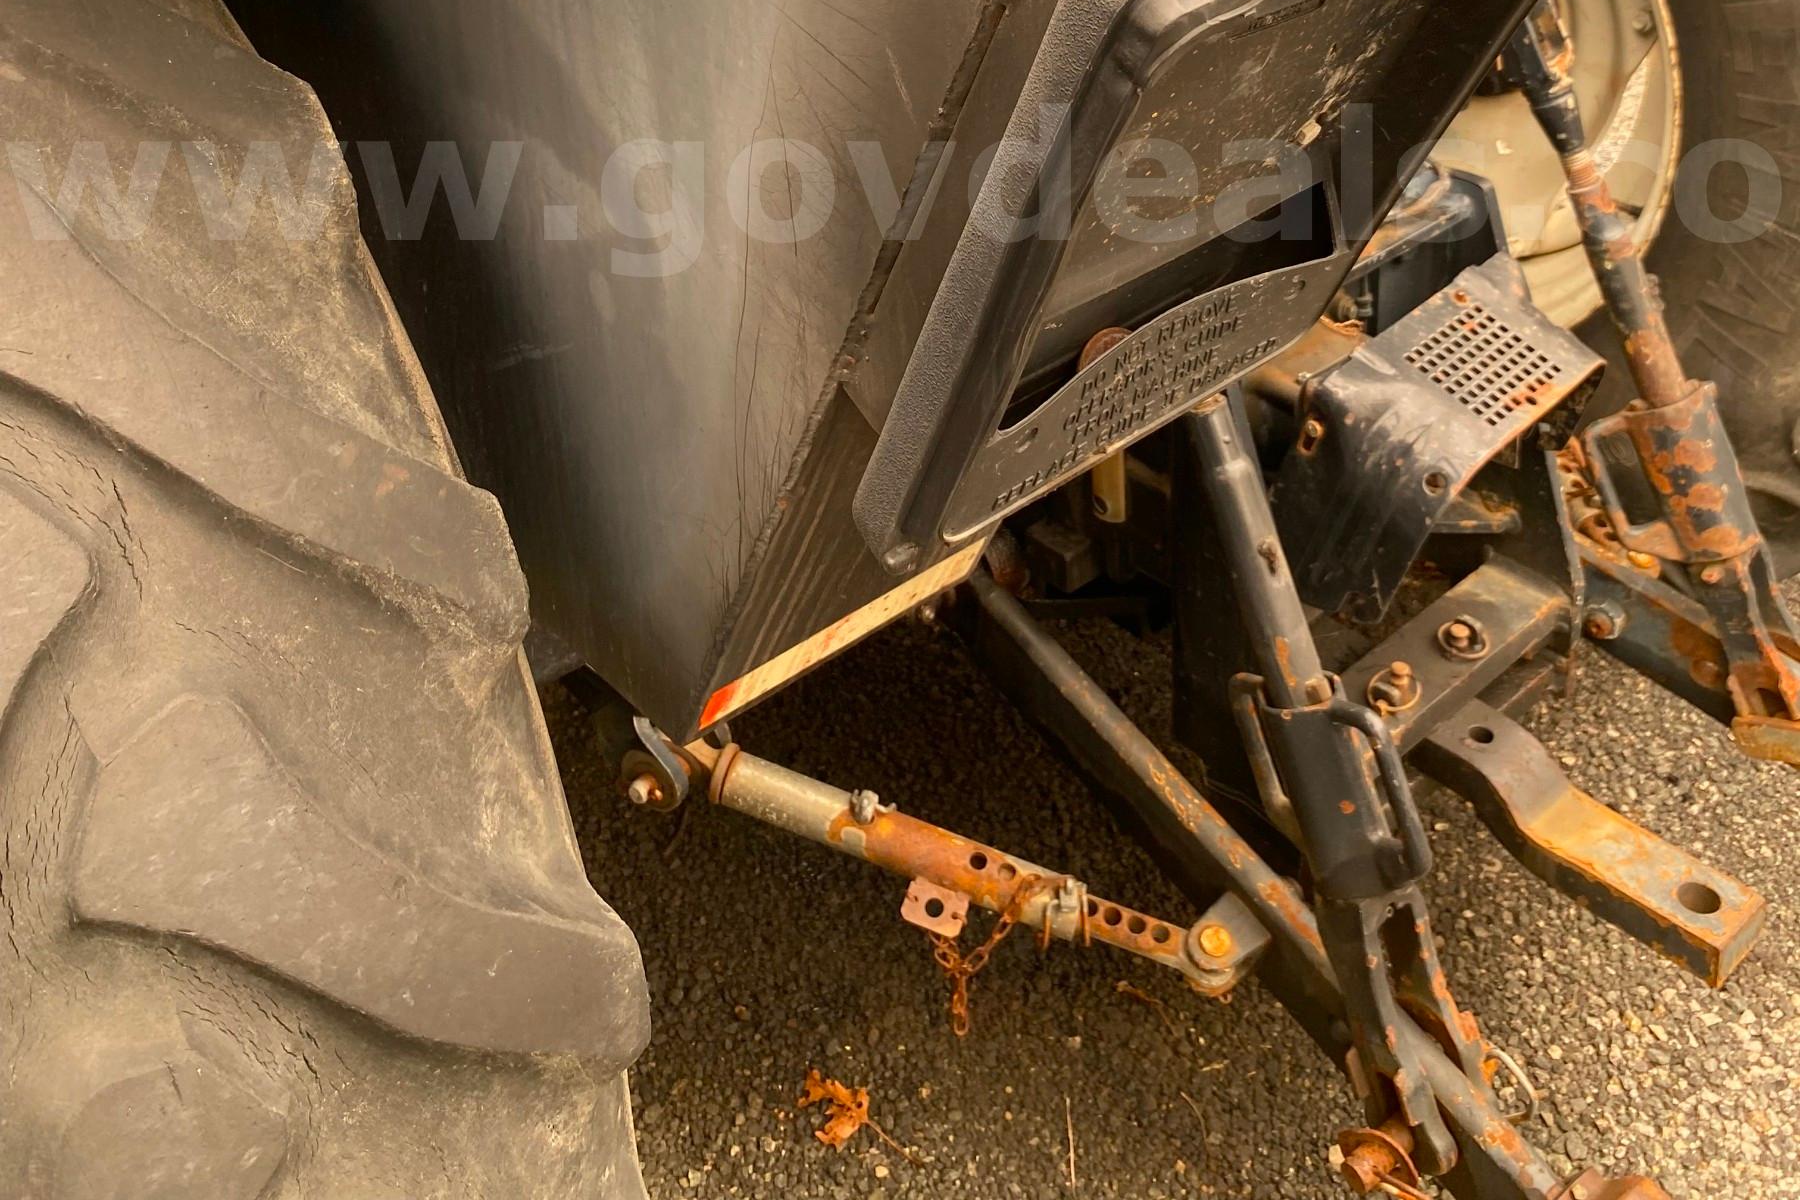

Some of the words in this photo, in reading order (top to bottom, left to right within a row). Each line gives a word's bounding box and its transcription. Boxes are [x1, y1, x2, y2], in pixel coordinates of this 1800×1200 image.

[1081, 370, 1107, 400] DO
[1157, 293, 1240, 345] REMOVE
[1184, 313, 1247, 352] GUIDE
[1072, 402, 1124, 444] FROM
[1132, 344, 1222, 405] MACHINE
[991, 442, 1088, 511] REPLACE
